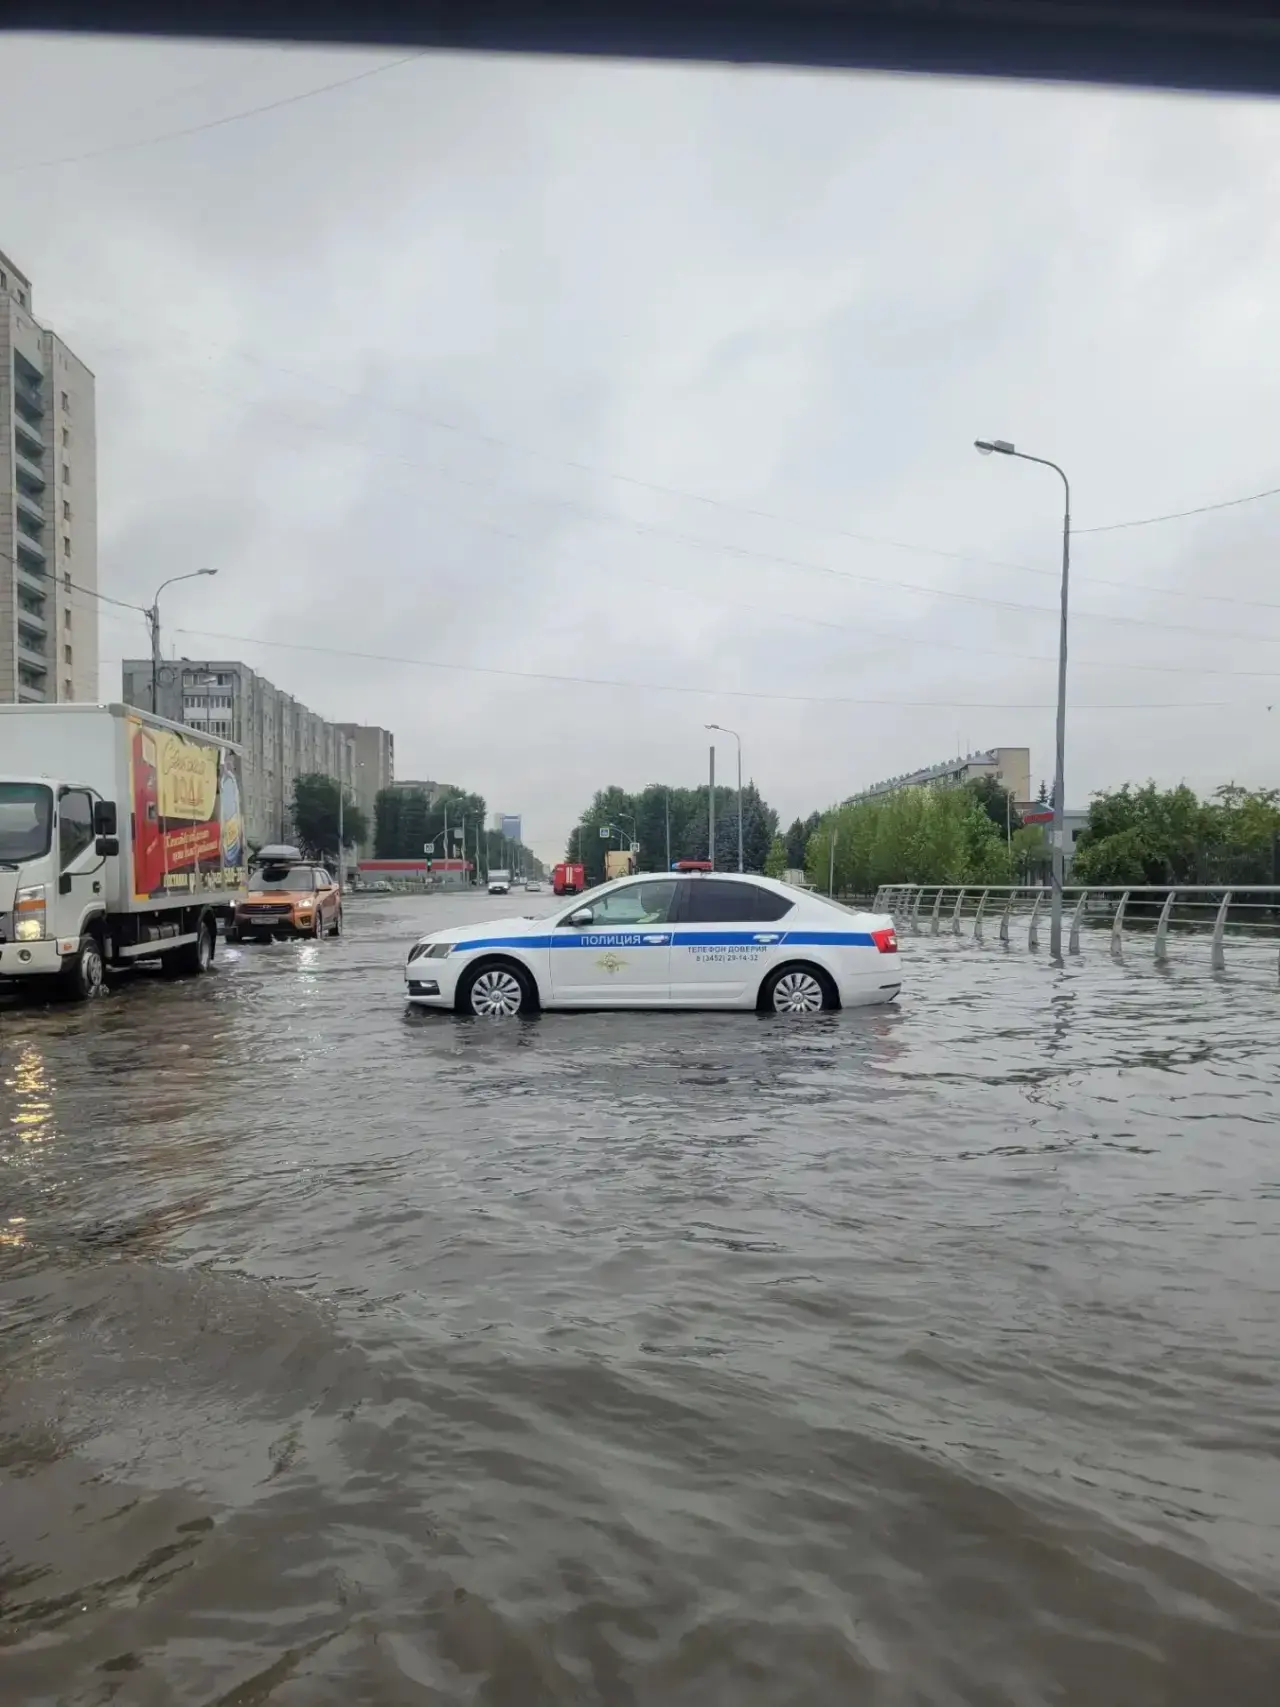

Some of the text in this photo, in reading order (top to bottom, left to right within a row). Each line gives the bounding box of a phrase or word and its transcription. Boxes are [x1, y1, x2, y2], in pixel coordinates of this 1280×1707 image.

[581, 935, 641, 946] ПОЛИЦИЯ
[688, 945, 767, 954] ТЕЛЕФОН ДОВЕРИЯ
[702, 954, 725, 963] (3452)
[727, 954, 758, 962] 29-14-32
